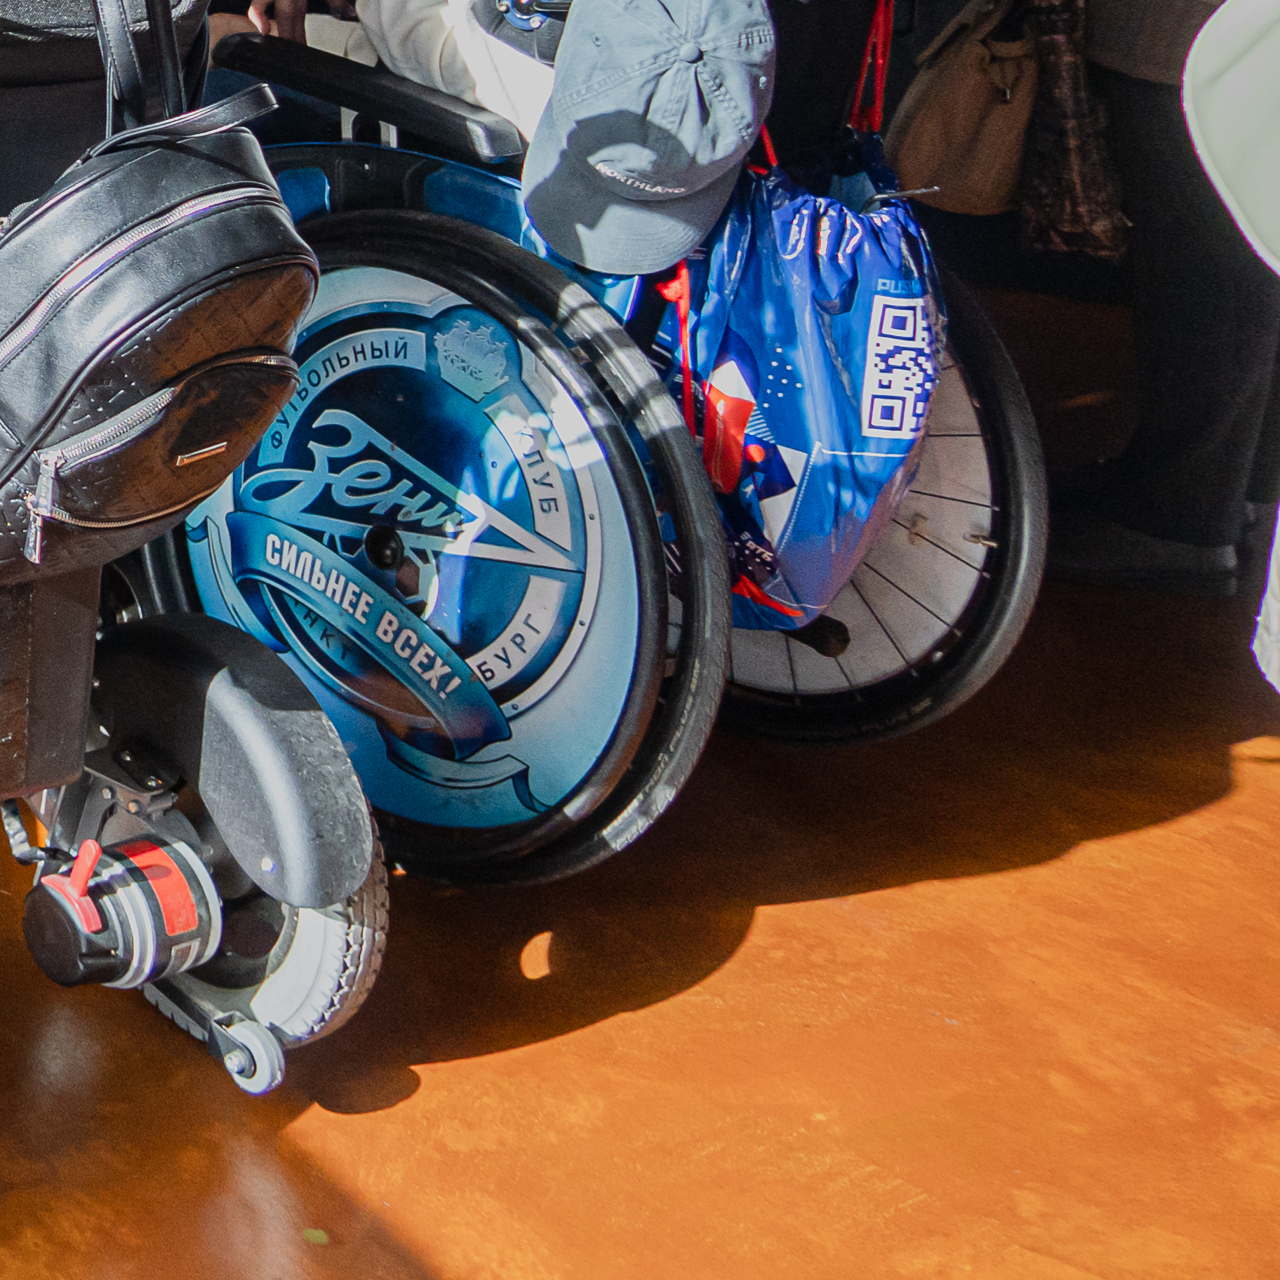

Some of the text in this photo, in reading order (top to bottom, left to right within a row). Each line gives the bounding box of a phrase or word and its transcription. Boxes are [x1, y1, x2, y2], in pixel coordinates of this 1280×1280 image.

[594, 162, 687, 194] NORTHLAND
[265, 533, 462, 700] СИЛЬНЕЕ ВСЕХ!
